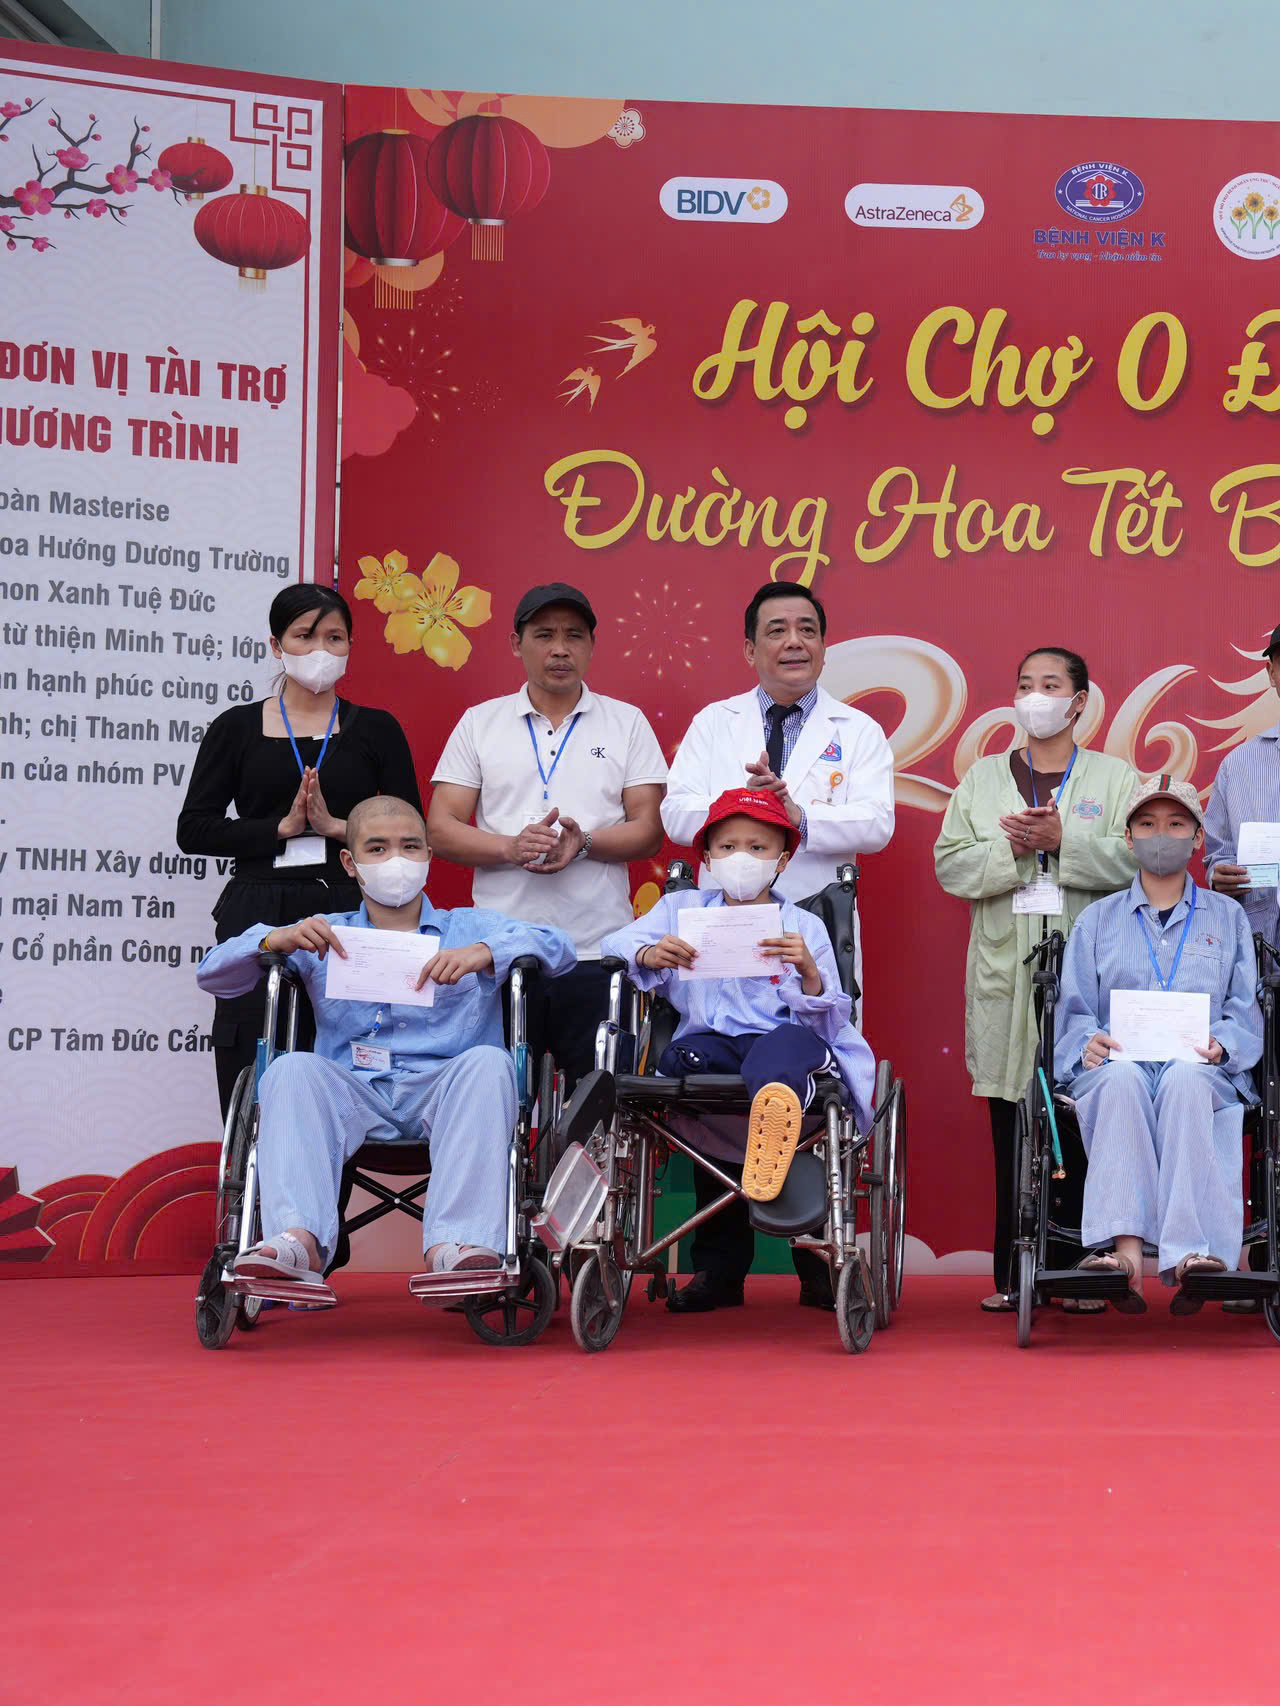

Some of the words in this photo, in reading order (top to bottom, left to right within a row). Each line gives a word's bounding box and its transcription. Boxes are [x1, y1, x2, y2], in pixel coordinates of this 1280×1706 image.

[1072, 163, 1095, 175] BỆNH
[1098, 163, 1119, 173] VIỆN
[677, 189, 747, 215] BIDV
[855, 205, 952, 222] AstraZeneca
[1033, 226, 1090, 248] BỆNH
[1095, 228, 1145, 249] VIỆN
[1150, 231, 1166, 248] K
[0, 340, 75, 386] ĐƠN
[92, 349, 128, 396] VỊ
[146, 346, 200, 397] TÀI
[217, 361, 288, 409] TRỢ
[692, 299, 874, 429] Hội
[905, 306, 1093, 436] Chợ
[0, 405, 111, 453] ƯƠNG
[128, 410, 239, 464] TRÌNH
[50, 491, 170, 522] Masterise
[543, 449, 830, 587] Đường
[854, 464, 1055, 563] Hoa
[1061, 467, 1184, 557] Tết
[39, 535, 116, 567] Hướng
[125, 540, 200, 573] Dương
[209, 547, 290, 578] Trường
[48, 580, 110, 606] Xanh
[118, 584, 162, 614] Tuệ
[170, 587, 216, 613] Đức
[3, 622, 28, 646] từ
[35, 624, 96, 654] thiện
[105, 628, 164, 653] Minh
[172, 631, 223, 661] Tuệ;
[232, 635, 267, 663] lớp
[27, 668, 87, 697] hạnh
[96, 673, 153, 700] phúc
[162, 676, 218, 705] cùng
[227, 679, 254, 702] cô
[41, 714, 77, 743] chị
[86, 716, 160, 741] Thanh
[24, 756, 68, 782] của
[77, 761, 144, 785] nhóm
[153, 763, 186, 786] PV
[16, 847, 87, 873] TNHH
[95, 849, 141, 878] Xây
[149, 851, 208, 881] dựng
[12, 893, 58, 921] mại
[67, 893, 123, 918] Nam
[131, 895, 176, 919] Tân
[12, 932, 44, 961] Cổ
[53, 935, 113, 966] phần
[121, 939, 182, 968] Công
[8, 1027, 42, 1052] CP
[51, 1027, 104, 1052] Tâm
[112, 1027, 159, 1052] Đức
